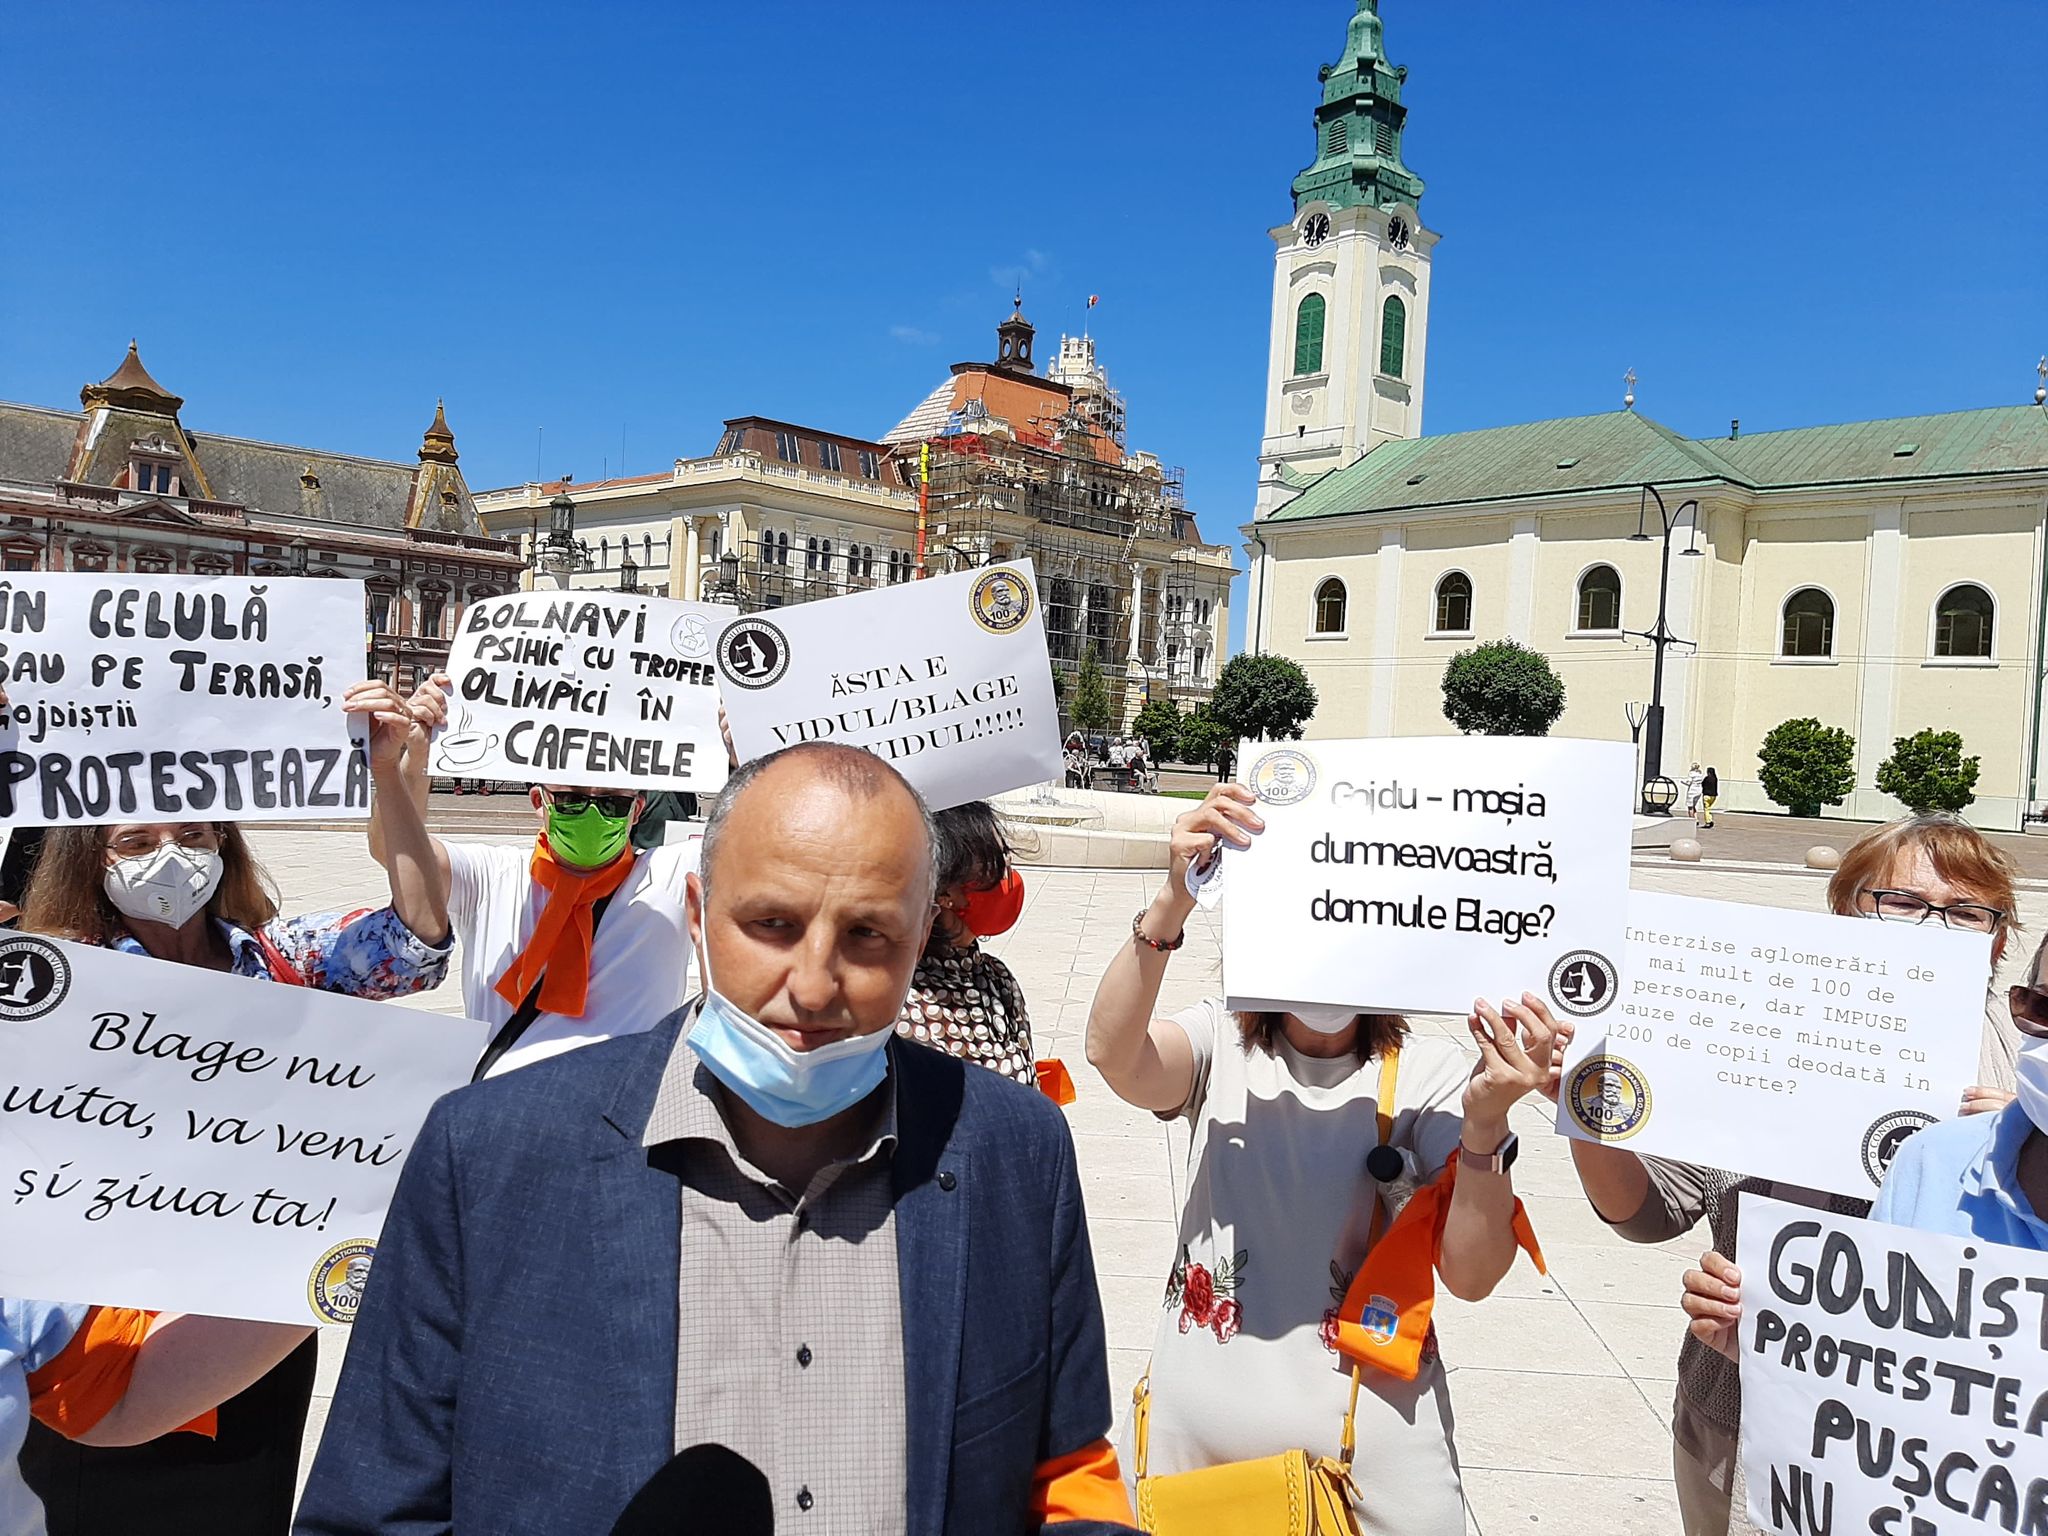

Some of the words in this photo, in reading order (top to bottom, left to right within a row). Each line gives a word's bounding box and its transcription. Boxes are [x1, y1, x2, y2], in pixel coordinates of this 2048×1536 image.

[0, 581, 46, 634] ÎN
[90, 585, 268, 642] CELULĂ
[990, 609, 1010, 621] 100
[92, 654, 144, 690] PE
[583, 645, 615, 670] CU
[630, 651, 715, 686] TROFEE
[832, 664, 917, 698] ĂSTA
[925, 655, 948, 678] E
[637, 687, 674, 721] ÎN
[771, 675, 1019, 745] VIDUL/BLAGE
[504, 720, 695, 778] CAFENELE
[0, 738, 369, 820] PROTESTEAZĂ
[1265, 787, 1289, 796] 100
[1452, 783, 1546, 827] moșia
[1310, 832, 1558, 885] dumneavoastră,
[1310, 889, 1447, 930] domnule
[1455, 897, 1556, 946] Blage?
[1649, 957, 1686, 973] mai
[1700, 965, 1753, 983] mult
[1768, 972, 1795, 989] de
[1811, 977, 1851, 997] 100
[1867, 986, 1895, 1004] de
[1750, 946, 1889, 976] aglomerări
[1906, 965, 1935, 983] de
[1632, 980, 1746, 1010] persoane,
[1765, 998, 1806, 1017] dar
[1823, 1006, 1907, 1033] IMPUSE
[89, 1011, 278, 1082] Blage
[285, 1056, 376, 1089] nu
[1621, 1003, 1675, 1022] auze
[1689, 1011, 1714, 1028] de
[1729, 1021, 1782, 1039] zece
[1796, 1030, 1882, 1056] minute
[1898, 1048, 1926, 1063] cu
[1604, 1023, 1653, 1043] 1200
[1666, 1033, 1691, 1050] de
[1706, 1040, 1771, 1065] copii
[1786, 1054, 1886, 1084] deodată
[1903, 1072, 1931, 1092] in
[1716, 1070, 1798, 1095] curte?
[3, 1084, 156, 1139] uita,
[187, 1110, 265, 1145] va
[276, 1124, 402, 1166] veni
[1588, 1105, 1613, 1121] 100
[1870, 1118, 1918, 1148] CONSILIUL
[14, 1161, 82, 1204] și
[84, 1173, 244, 1221] ziua
[252, 1188, 337, 1231] ta!
[316, 1266, 330, 1303] COLEGIUL
[332, 1294, 359, 1309] 100
[1770, 1463, 1834, 1536] NU
